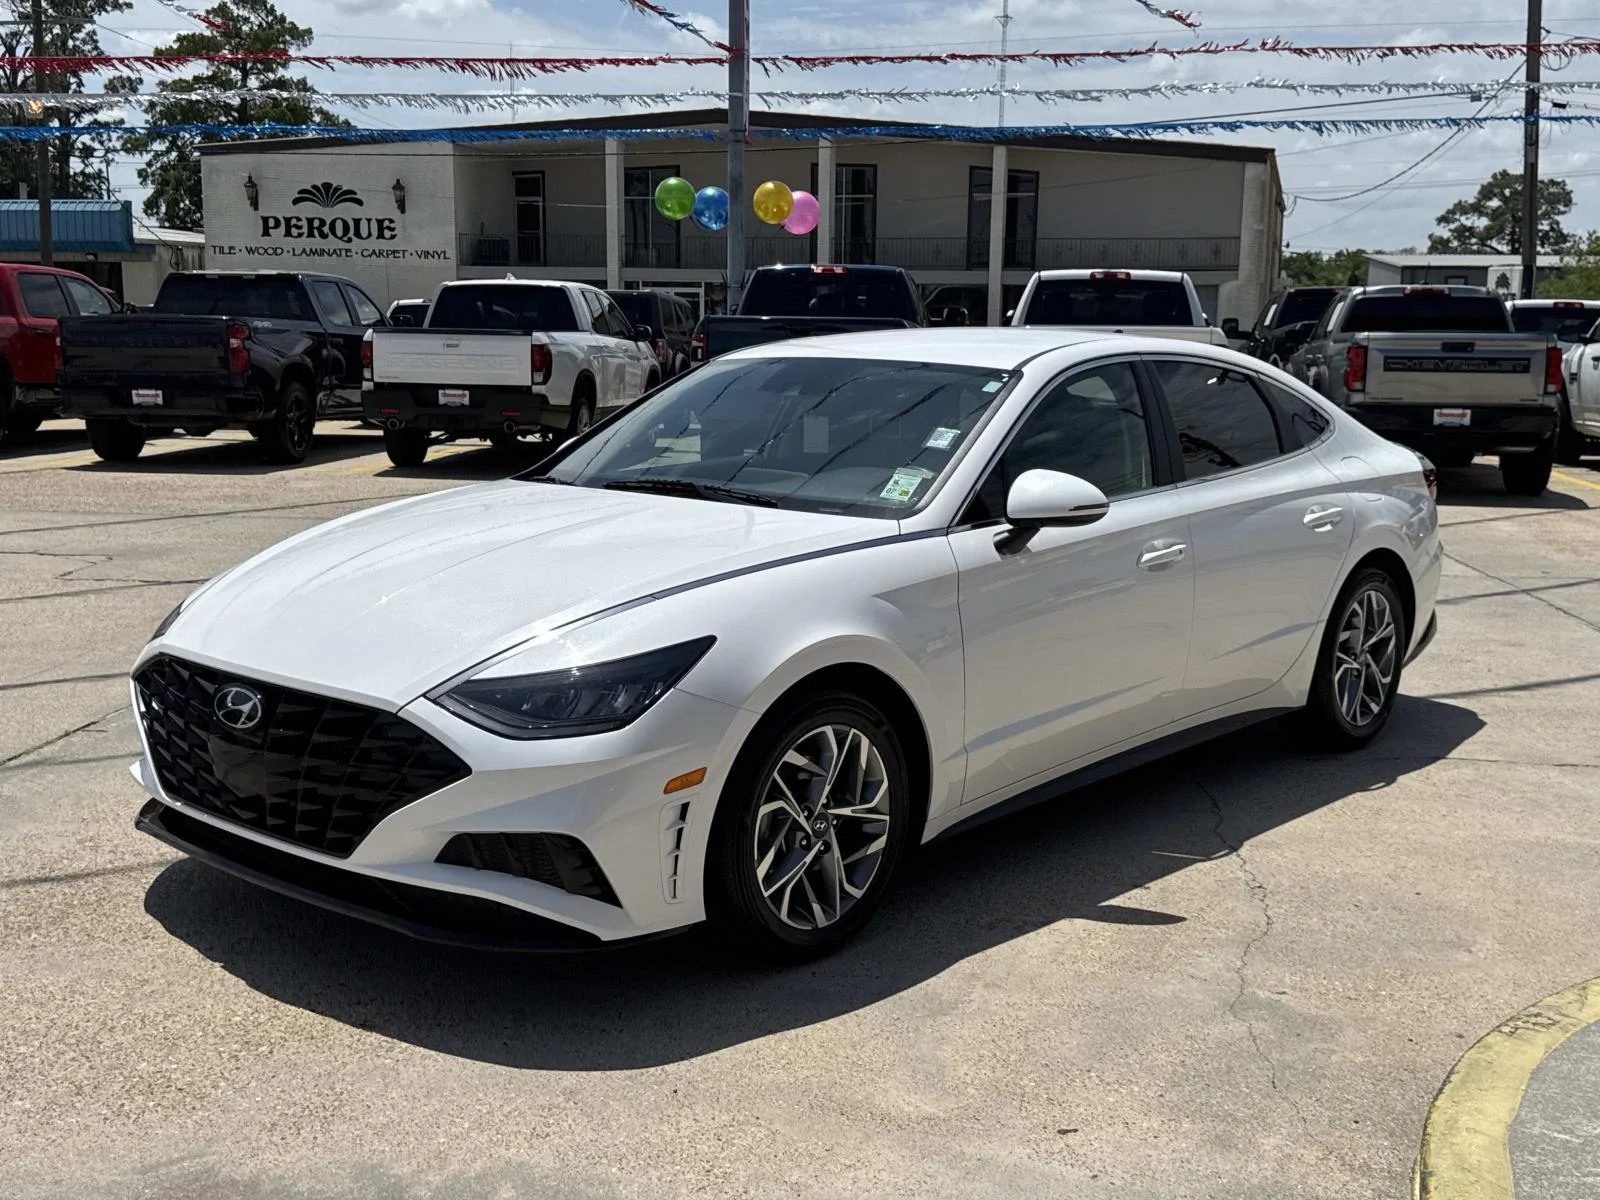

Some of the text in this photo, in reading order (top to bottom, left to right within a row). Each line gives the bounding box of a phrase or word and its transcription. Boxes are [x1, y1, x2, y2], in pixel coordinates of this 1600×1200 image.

[260, 215, 397, 243] PERQUE
[210, 245, 451, 260] TILE WOOD LAMINATE CARPET VINYL
[1385, 359, 1529, 371] CHEVROLET
